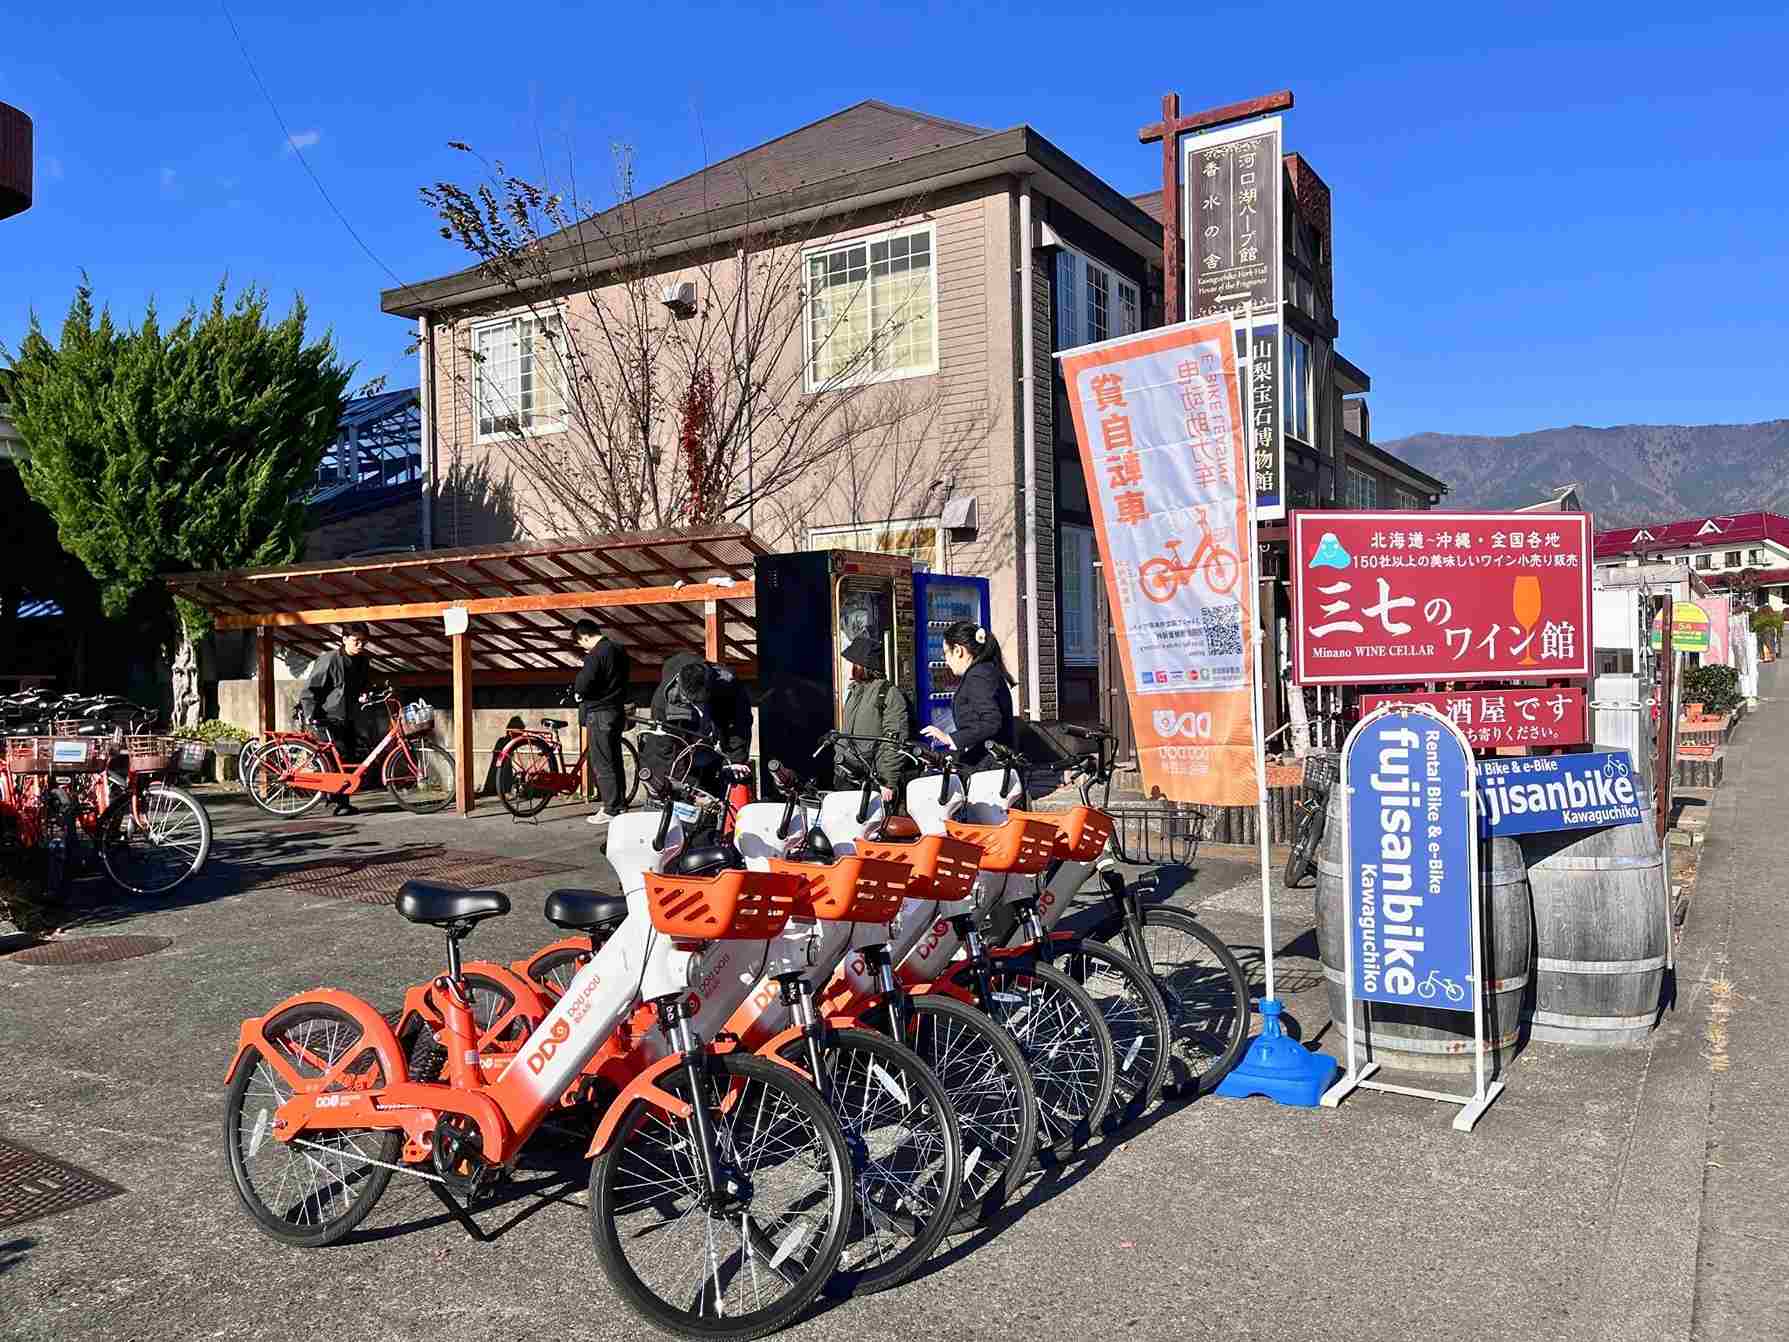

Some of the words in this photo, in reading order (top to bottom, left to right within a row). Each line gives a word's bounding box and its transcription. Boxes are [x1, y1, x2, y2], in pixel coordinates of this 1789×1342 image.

[1237, 152, 1258, 264] 河口湖ハーブ館
[1253, 340, 1274, 491] 山梨宝石博物館
[1308, 577, 1453, 638] 三七の
[1312, 646, 1352, 658] Minano
[1354, 645, 1386, 658] WINE
[1388, 644, 1435, 657] CELLAR
[1444, 620, 1576, 661] ワイン館
[1376, 694, 1573, 724] 酒屋です
[1464, 725, 1560, 743] ち寄りください。
[1425, 730, 1441, 784] Rental
[1484, 762, 1510, 776] Bike
[1511, 760, 1522, 774] &
[1523, 758, 1558, 772] e-Bike
[1427, 786, 1443, 822] Bike
[1562, 804, 1640, 826] Kawaguchiko
[1428, 825, 1442, 838] &
[1370, 728, 1425, 995] fujisanbike
[1428, 843, 1444, 895] e-Bike
[1358, 863, 1381, 993] Kawaguchiko
